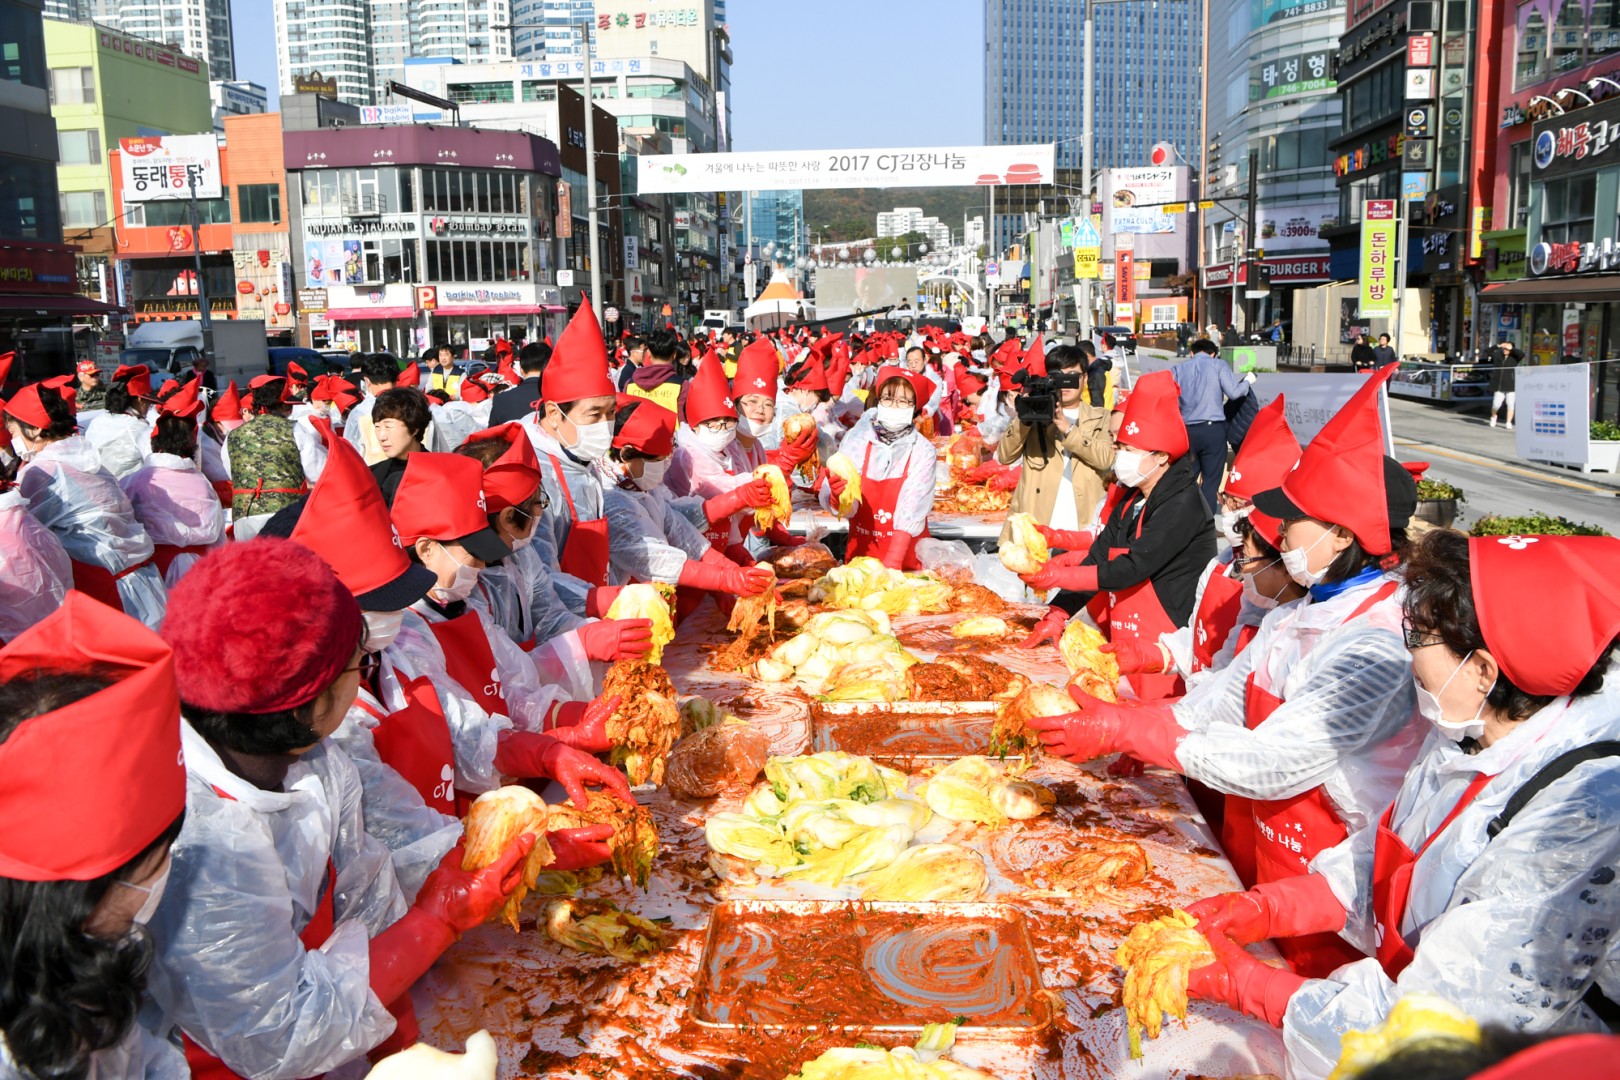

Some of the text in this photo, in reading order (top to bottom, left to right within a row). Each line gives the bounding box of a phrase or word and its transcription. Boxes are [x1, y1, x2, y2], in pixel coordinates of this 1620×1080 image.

[705, 160, 821, 174] 겨울에 나누는 따뜻한 사랑
[828, 153, 967, 173] 2017 CJ김장나눔
[132, 164, 205, 191] 동래통닭
[308, 221, 410, 235] INDIAN RESTAURANT
[448, 221, 492, 233] Bombay
[1270, 261, 1318, 275] BURGER
[1369, 232, 1387, 300] 돈하루방
[418, 288, 434, 309] P
[446, 290, 474, 301] baskin
[490, 290, 521, 301] robbins
[1124, 622, 1138, 631] 나눔
[483, 682, 498, 696] CJ
[433, 781, 446, 799] CJ
[1278, 833, 1303, 853] 나눔
